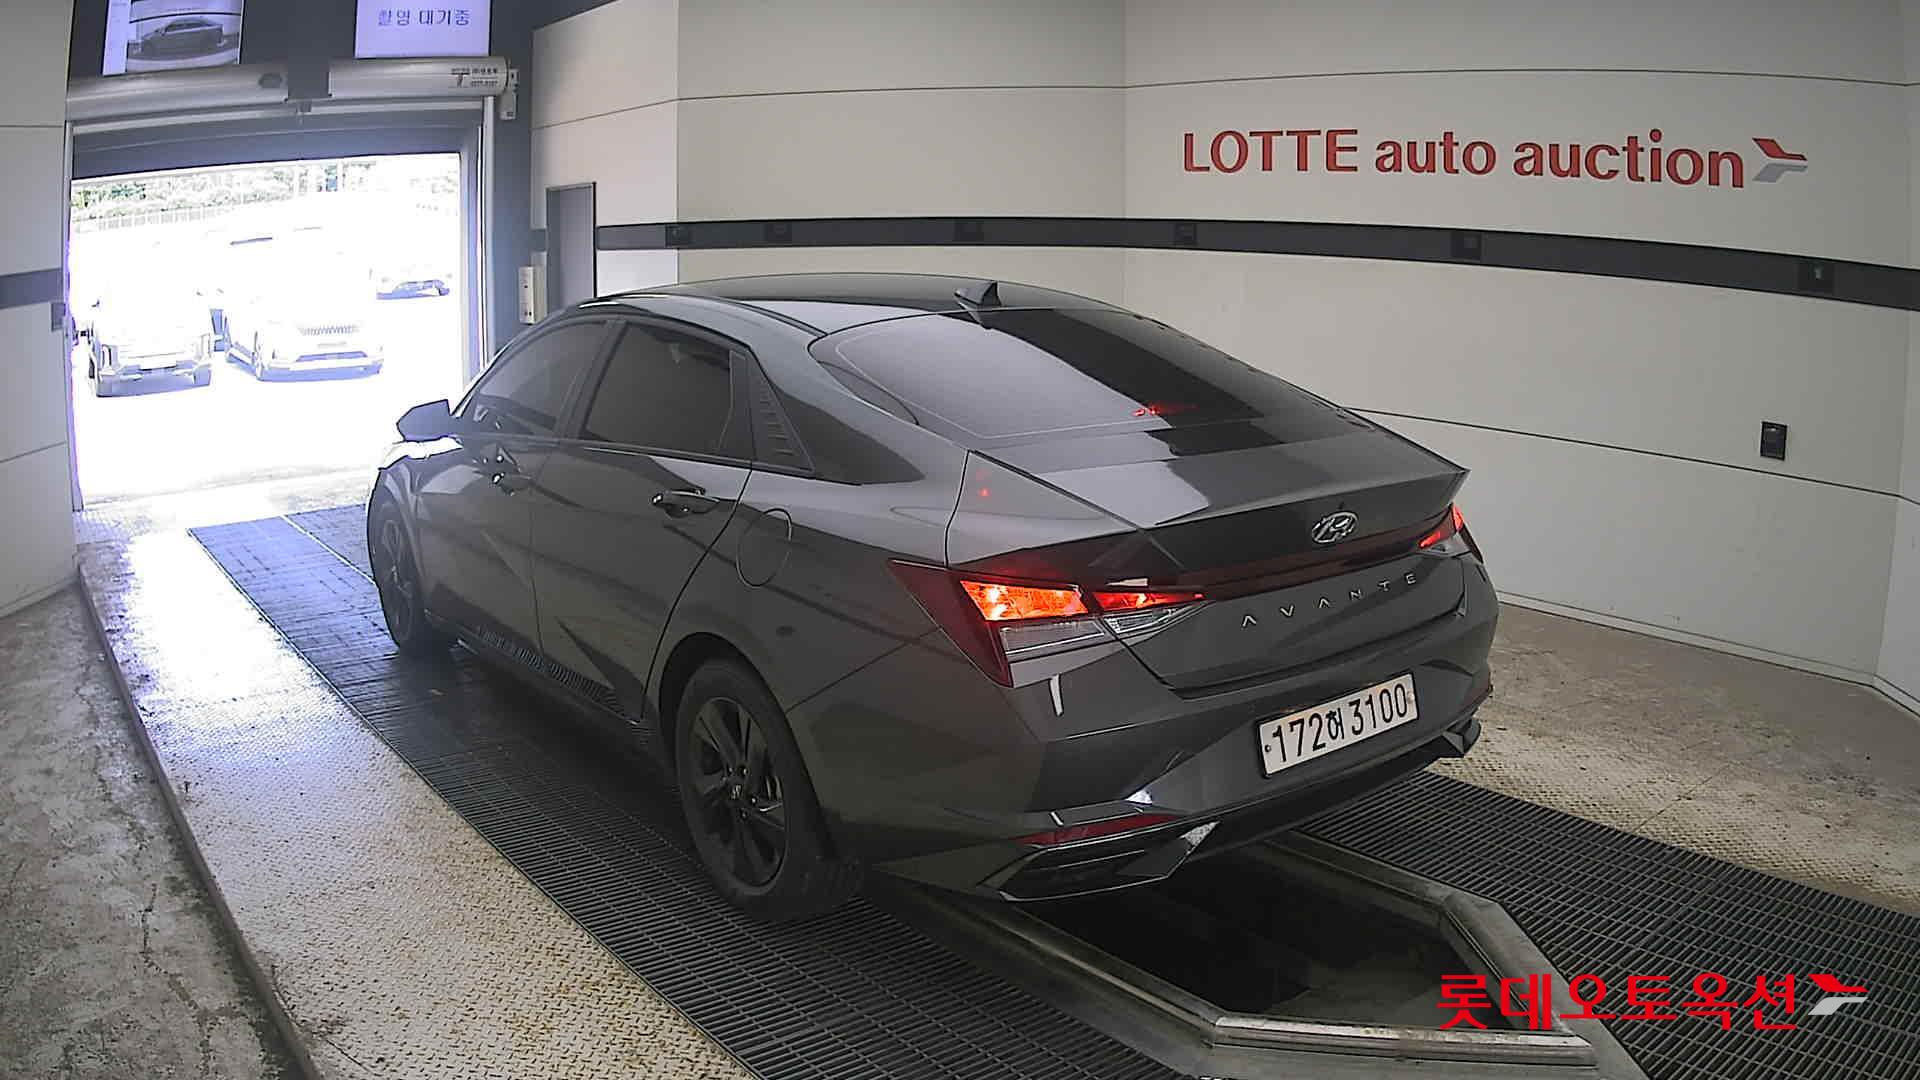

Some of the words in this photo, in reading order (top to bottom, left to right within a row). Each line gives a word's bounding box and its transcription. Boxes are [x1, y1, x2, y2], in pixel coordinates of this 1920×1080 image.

[419, 9, 471, 26] 대기중
[1183, 128, 1358, 174] LOTTE
[1374, 131, 1497, 176] auto
[1512, 128, 1744, 189] auction
[1241, 572, 1417, 628] AVANTE
